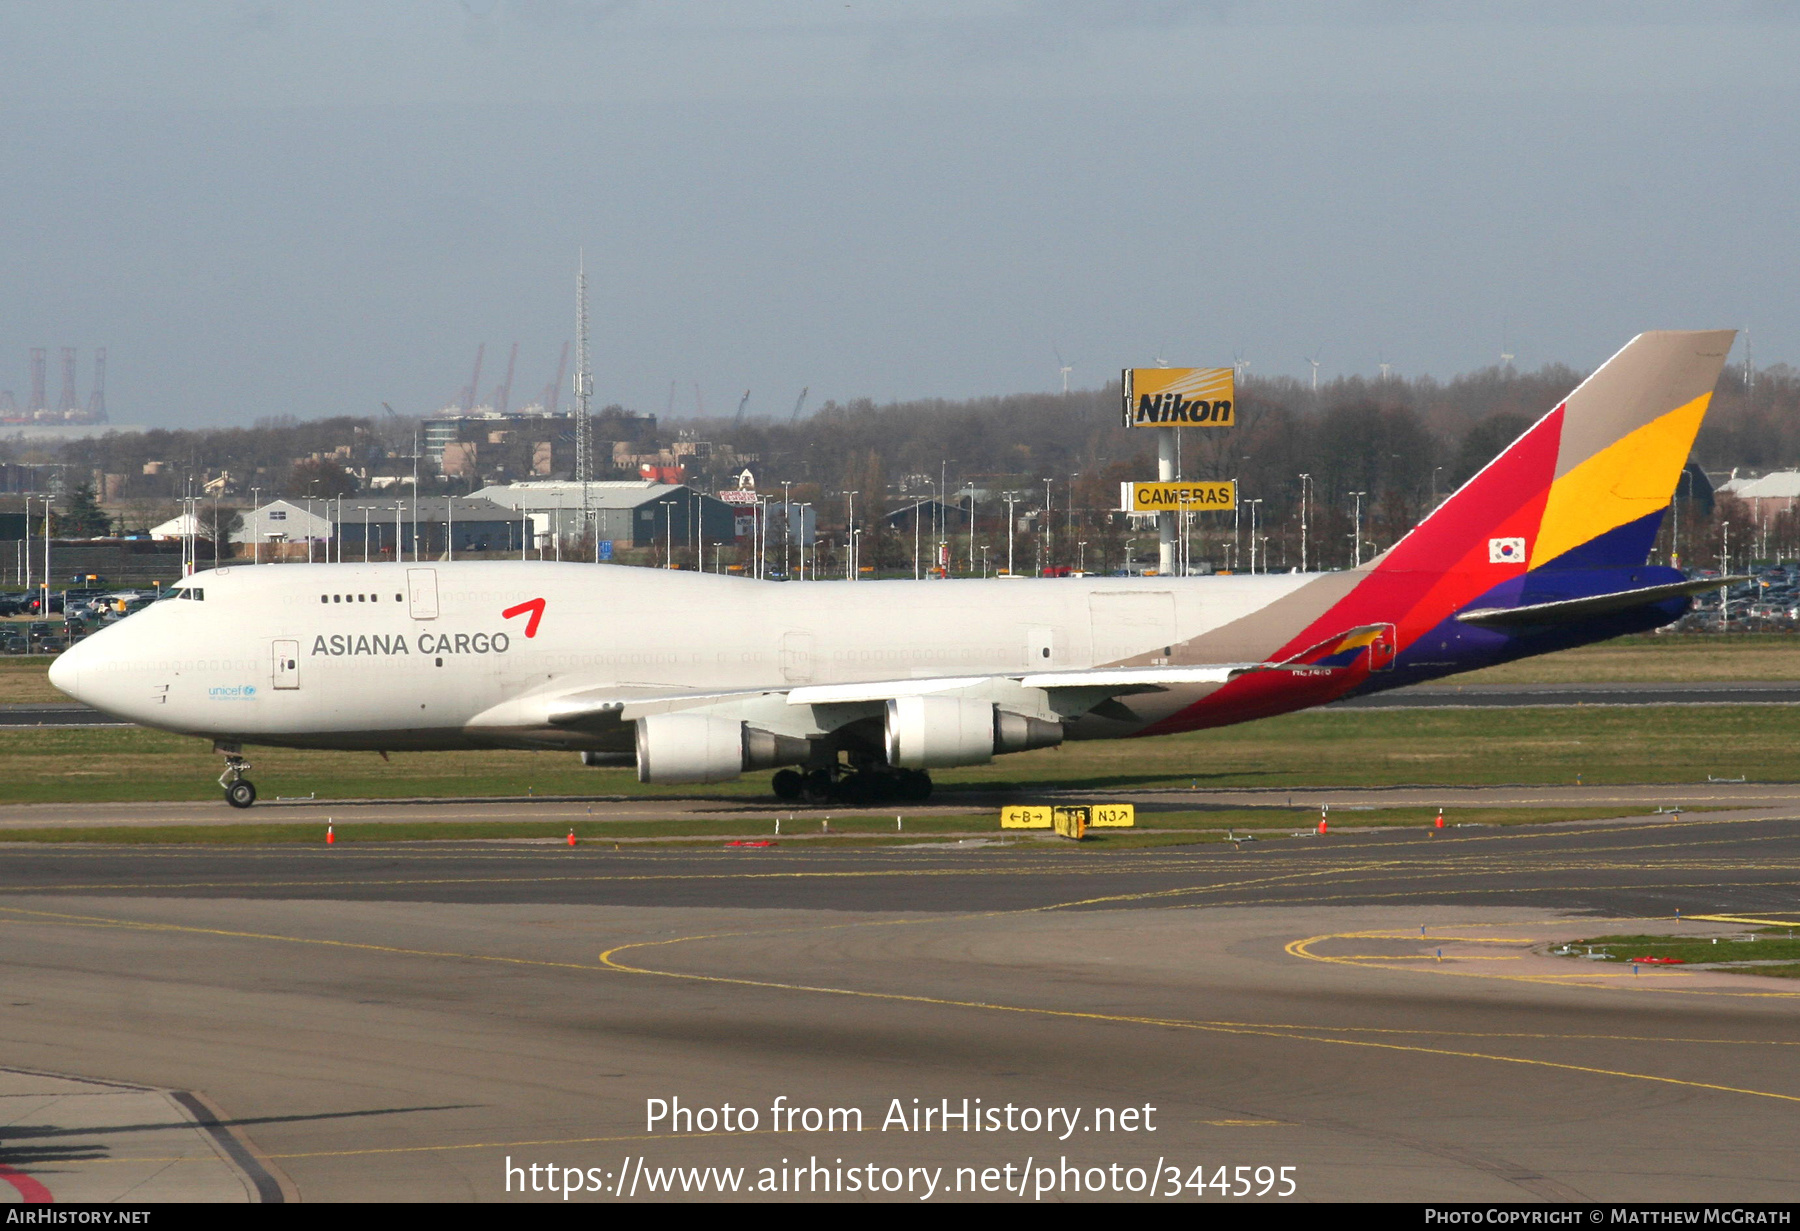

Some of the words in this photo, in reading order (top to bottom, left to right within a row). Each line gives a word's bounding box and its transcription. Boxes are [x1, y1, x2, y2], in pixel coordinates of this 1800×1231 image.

[1136, 393, 1232, 423] Nikon
[1137, 488, 1230, 504] CAMERAS
[311, 634, 409, 656] ASIANA
[417, 632, 510, 655] CARGO
[208, 684, 242, 696] unicef
[1022, 811, 1031, 822] B
[1098, 810, 1117, 822] N3
